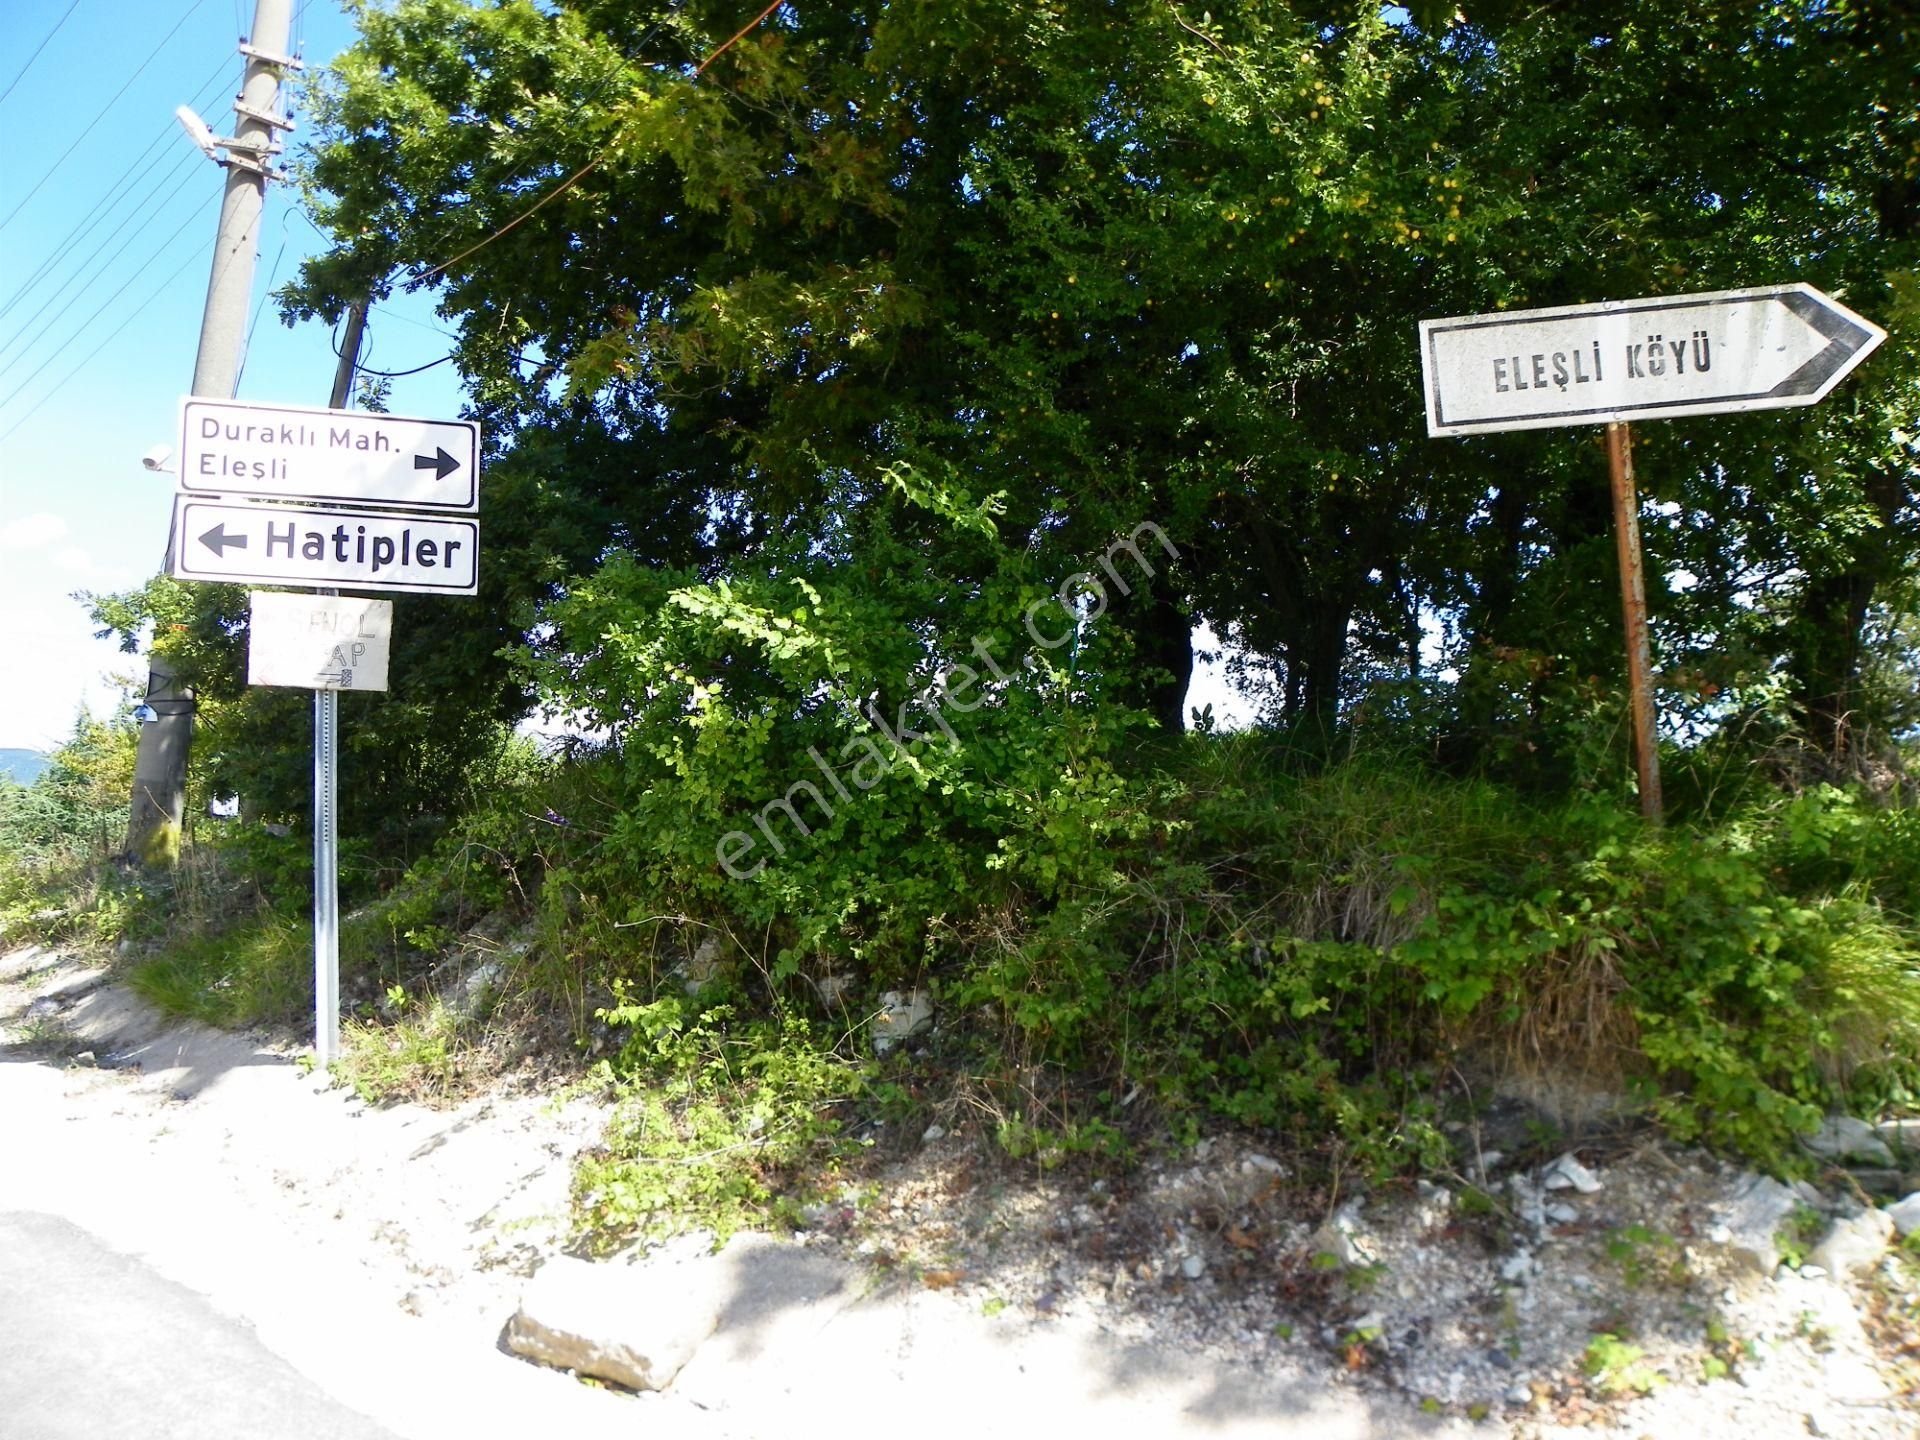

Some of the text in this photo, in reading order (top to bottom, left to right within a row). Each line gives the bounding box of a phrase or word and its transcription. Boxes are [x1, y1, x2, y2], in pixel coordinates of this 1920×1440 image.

[1493, 330, 1712, 393] ELEŞLİ KÖYÜ
[201, 417, 401, 453] Duraklı Mah.
[200, 453, 288, 480] Eleşli
[266, 521, 461, 572] Hatipler
